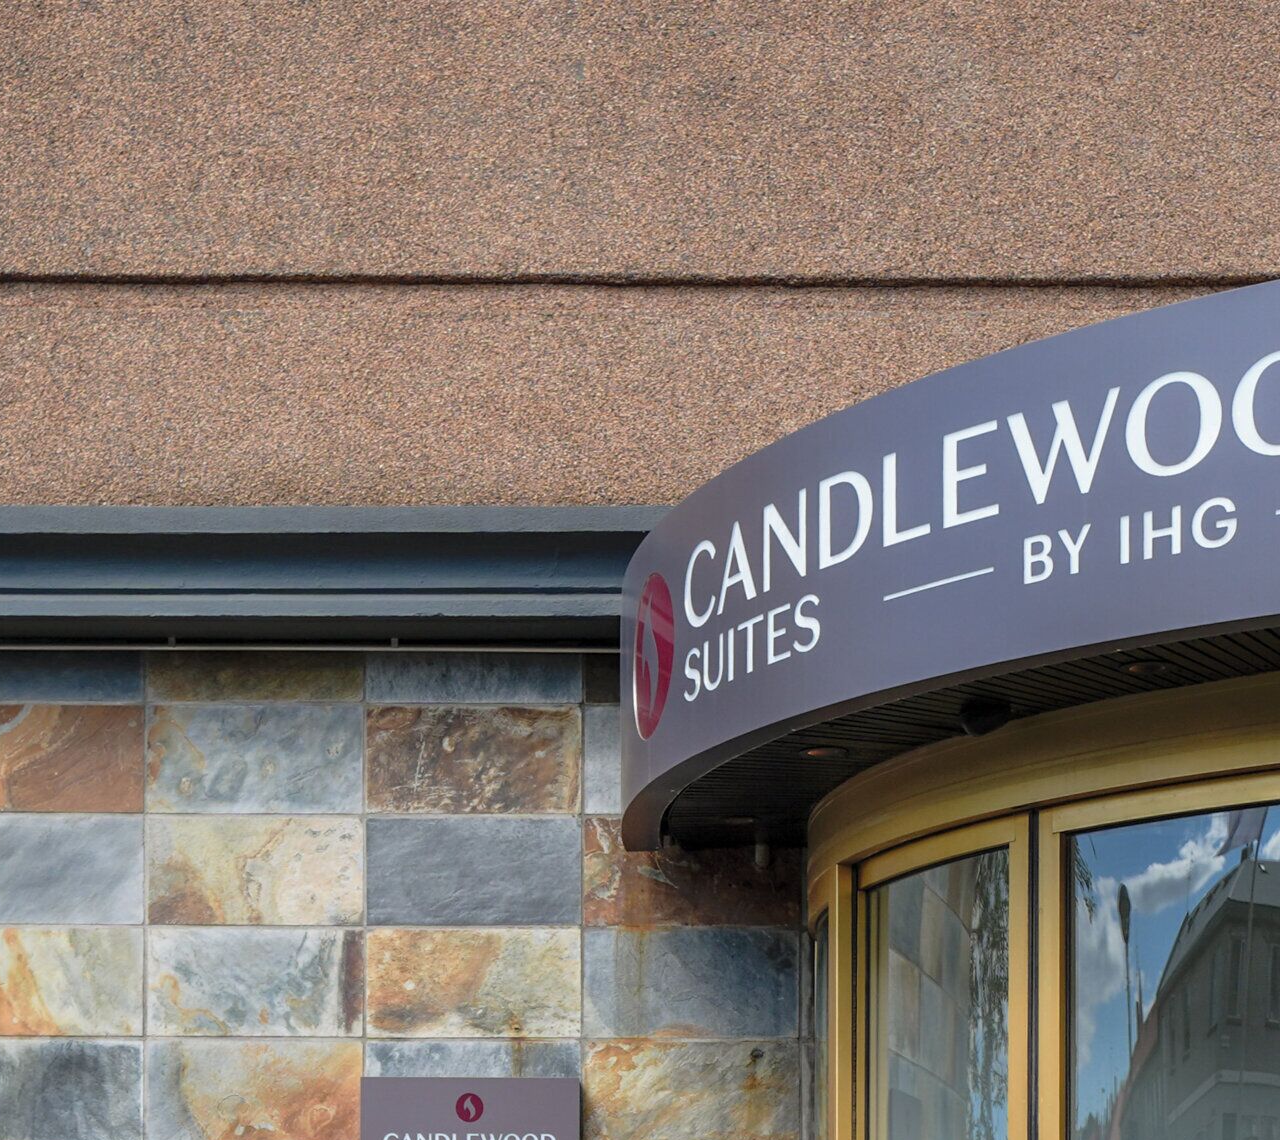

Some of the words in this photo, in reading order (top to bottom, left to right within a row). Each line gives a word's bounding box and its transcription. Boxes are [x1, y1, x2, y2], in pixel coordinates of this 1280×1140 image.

[1023, 523, 1092, 585] BY
[1119, 496, 1238, 565] IHG
[683, 594, 821, 702] SUITES
